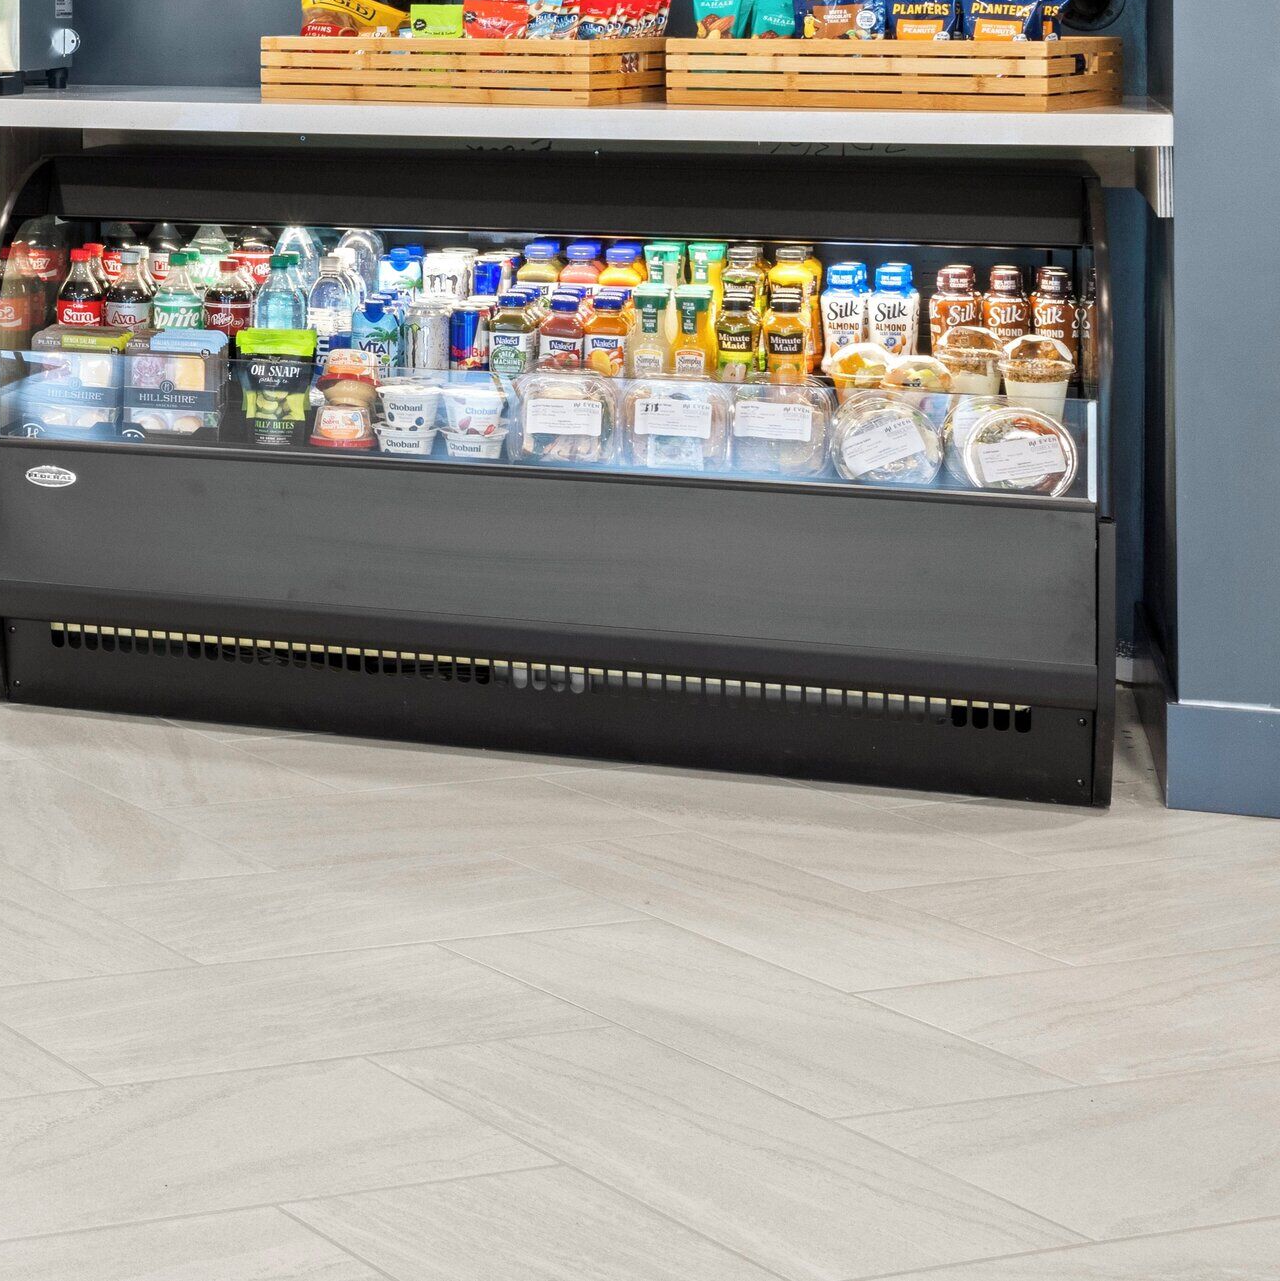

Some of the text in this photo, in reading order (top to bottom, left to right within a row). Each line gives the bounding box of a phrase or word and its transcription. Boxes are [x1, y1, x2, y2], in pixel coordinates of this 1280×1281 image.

[700, 0, 734, 8] SAHALE
[892, 3, 950, 15] PLANTERS
[971, 2, 1031, 17] PLANTERS
[306, 25, 332, 33] THINS
[63, 308, 94, 322] Sara
[827, 300, 860, 321] Silk
[874, 302, 908, 322] Silk
[946, 305, 977, 326] Silk
[111, 311, 136, 325] Ava
[154, 306, 200, 328] Sprite
[989, 306, 1024, 327] Silk
[1034, 306, 1066, 327] Silk
[828, 322, 860, 331] ALMOND
[875, 323, 907, 331] ALMOND
[718, 333, 750, 344] Minute
[770, 336, 801, 346] Minute
[358, 341, 387, 354] VITA
[721, 340, 747, 351] Maid
[774, 343, 798, 352] Maid
[493, 357, 521, 366] MACHINE
[251, 364, 301, 378] OH SNAP!
[47, 389, 101, 400] HILLSHIRE
[139, 394, 196, 404] HILLSHIRE
[389, 403, 423, 412] Chobani
[465, 407, 498, 415] Chobani
[272, 421, 295, 430] BITES
[386, 439, 420, 449] Chobani
[1038, 436, 1058, 445] EVEN
[449, 443, 482, 453] Chobani
